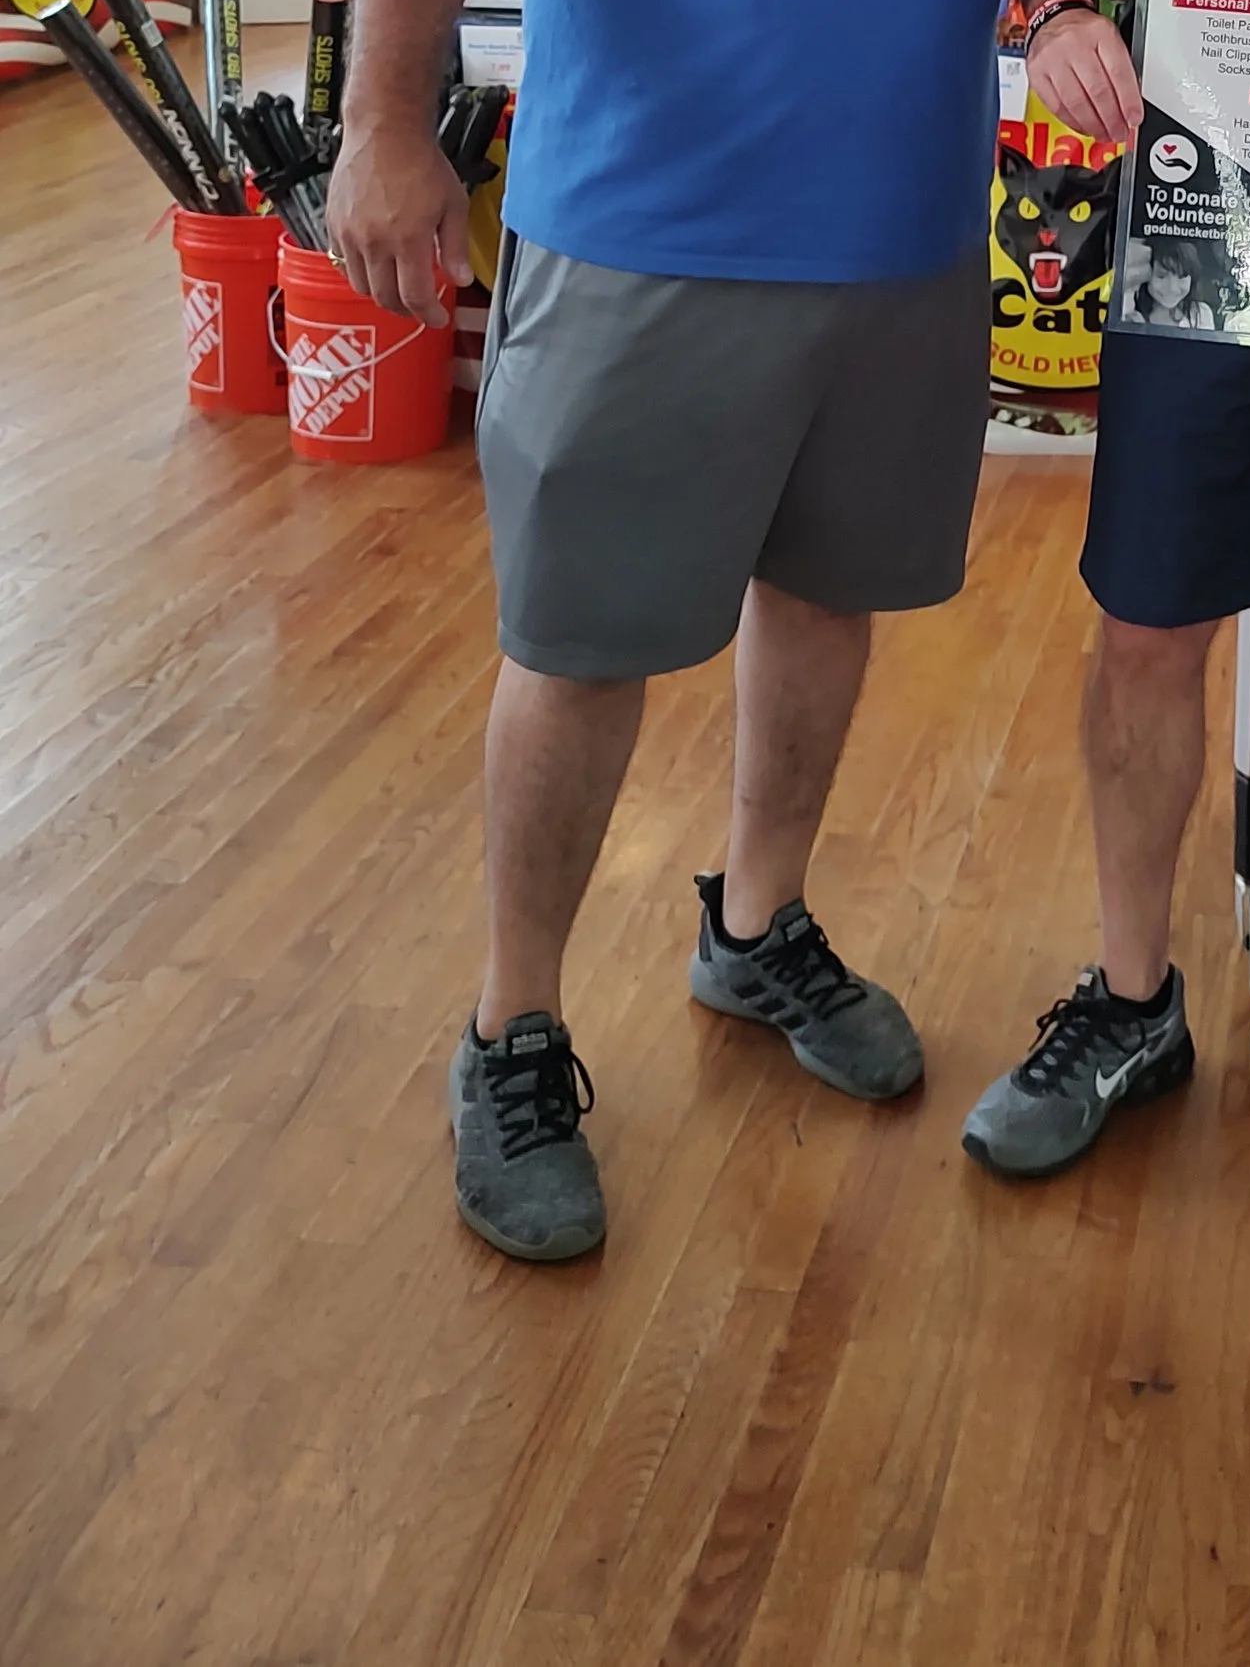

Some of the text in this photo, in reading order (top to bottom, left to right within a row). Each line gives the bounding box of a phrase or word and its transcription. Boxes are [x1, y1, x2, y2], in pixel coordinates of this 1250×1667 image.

[1206, 17, 1235, 30] Toilet
[1201, 46, 1223, 59] Nail
[994, 119, 1126, 172] Blac
[1147, 185, 1168, 202] To
[1172, 187, 1238, 208] Donate
[1145, 202, 1235, 227] Volunteer
